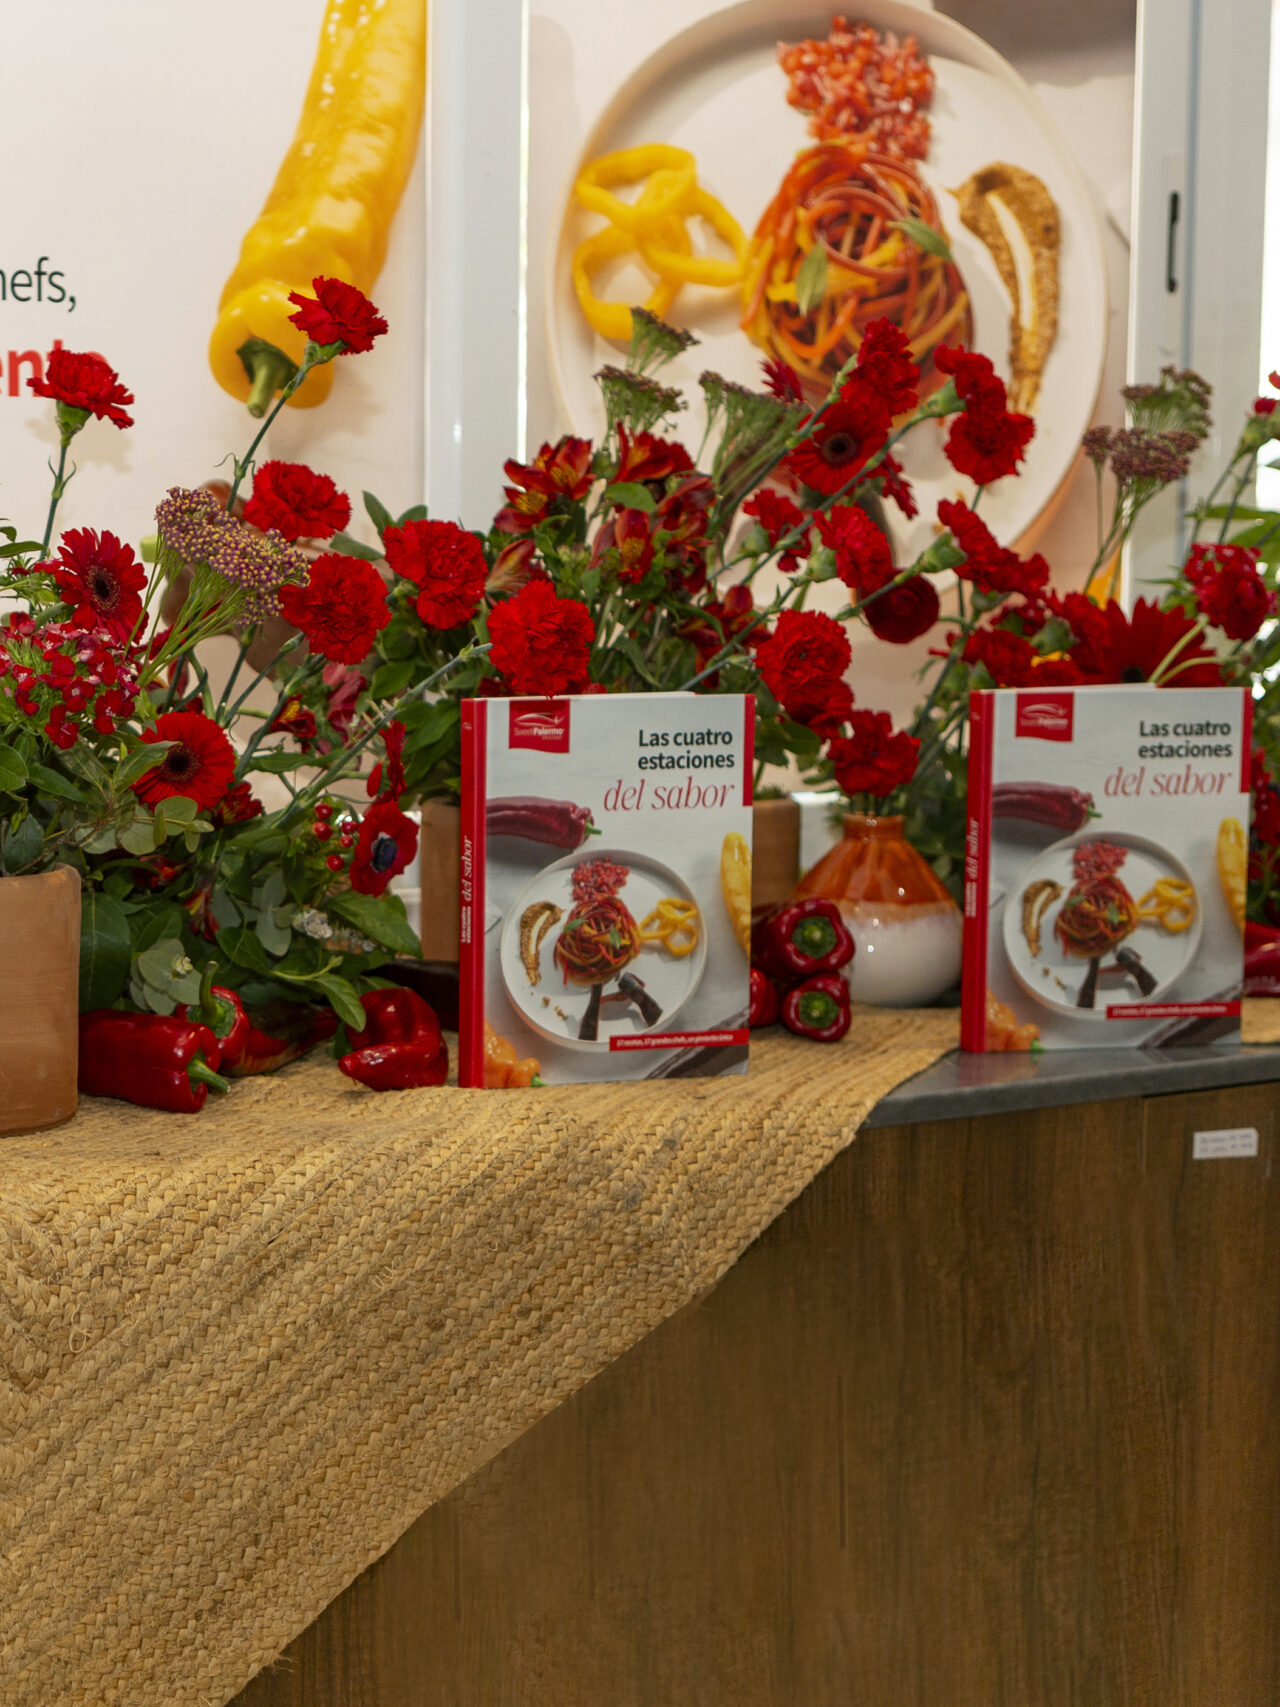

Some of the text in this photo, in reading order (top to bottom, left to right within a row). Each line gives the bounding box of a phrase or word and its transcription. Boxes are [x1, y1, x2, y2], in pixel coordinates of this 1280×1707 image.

[638, 728, 733, 748] Las cuatro
[1138, 720, 1232, 738] Las cuatro
[1138, 740, 1233, 759] estaciones
[637, 750, 735, 771] estaciones
[1104, 765, 1233, 796] del sabor
[604, 776, 735, 811] del sabor
[461, 835, 472, 902] del sabor
